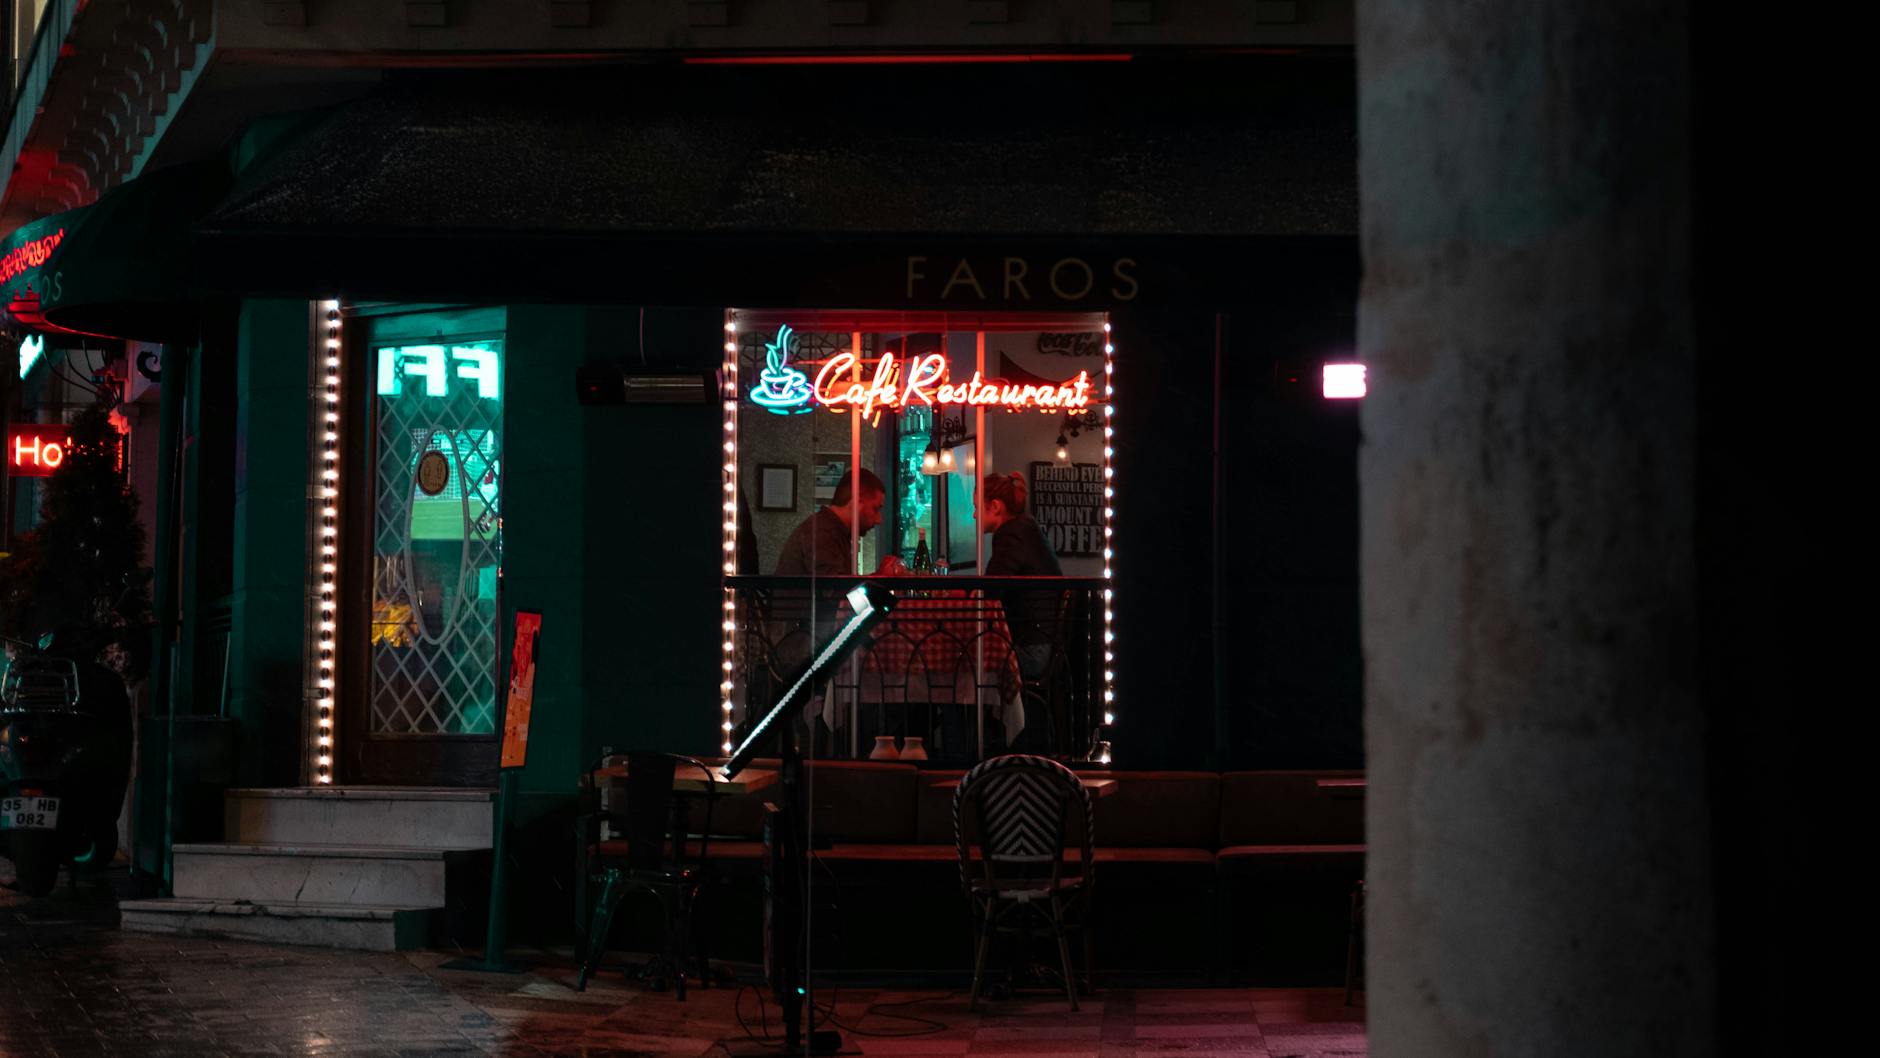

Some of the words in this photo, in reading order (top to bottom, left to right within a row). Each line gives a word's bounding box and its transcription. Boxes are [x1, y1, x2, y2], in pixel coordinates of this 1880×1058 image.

[906, 255, 1140, 301] FAROS
[900, 354, 1088, 406] Restaurant
[1036, 464, 1079, 481] BEHIND
[1035, 481, 1081, 492] SUCCESSFUL
[1036, 493, 1045, 505] IS
[1046, 493, 1053, 505] A
[1036, 505, 1093, 525] AMOUNT
[4, 800, 21, 811] 35
[38, 799, 57, 811] HB
[16, 814, 45, 825] 082
